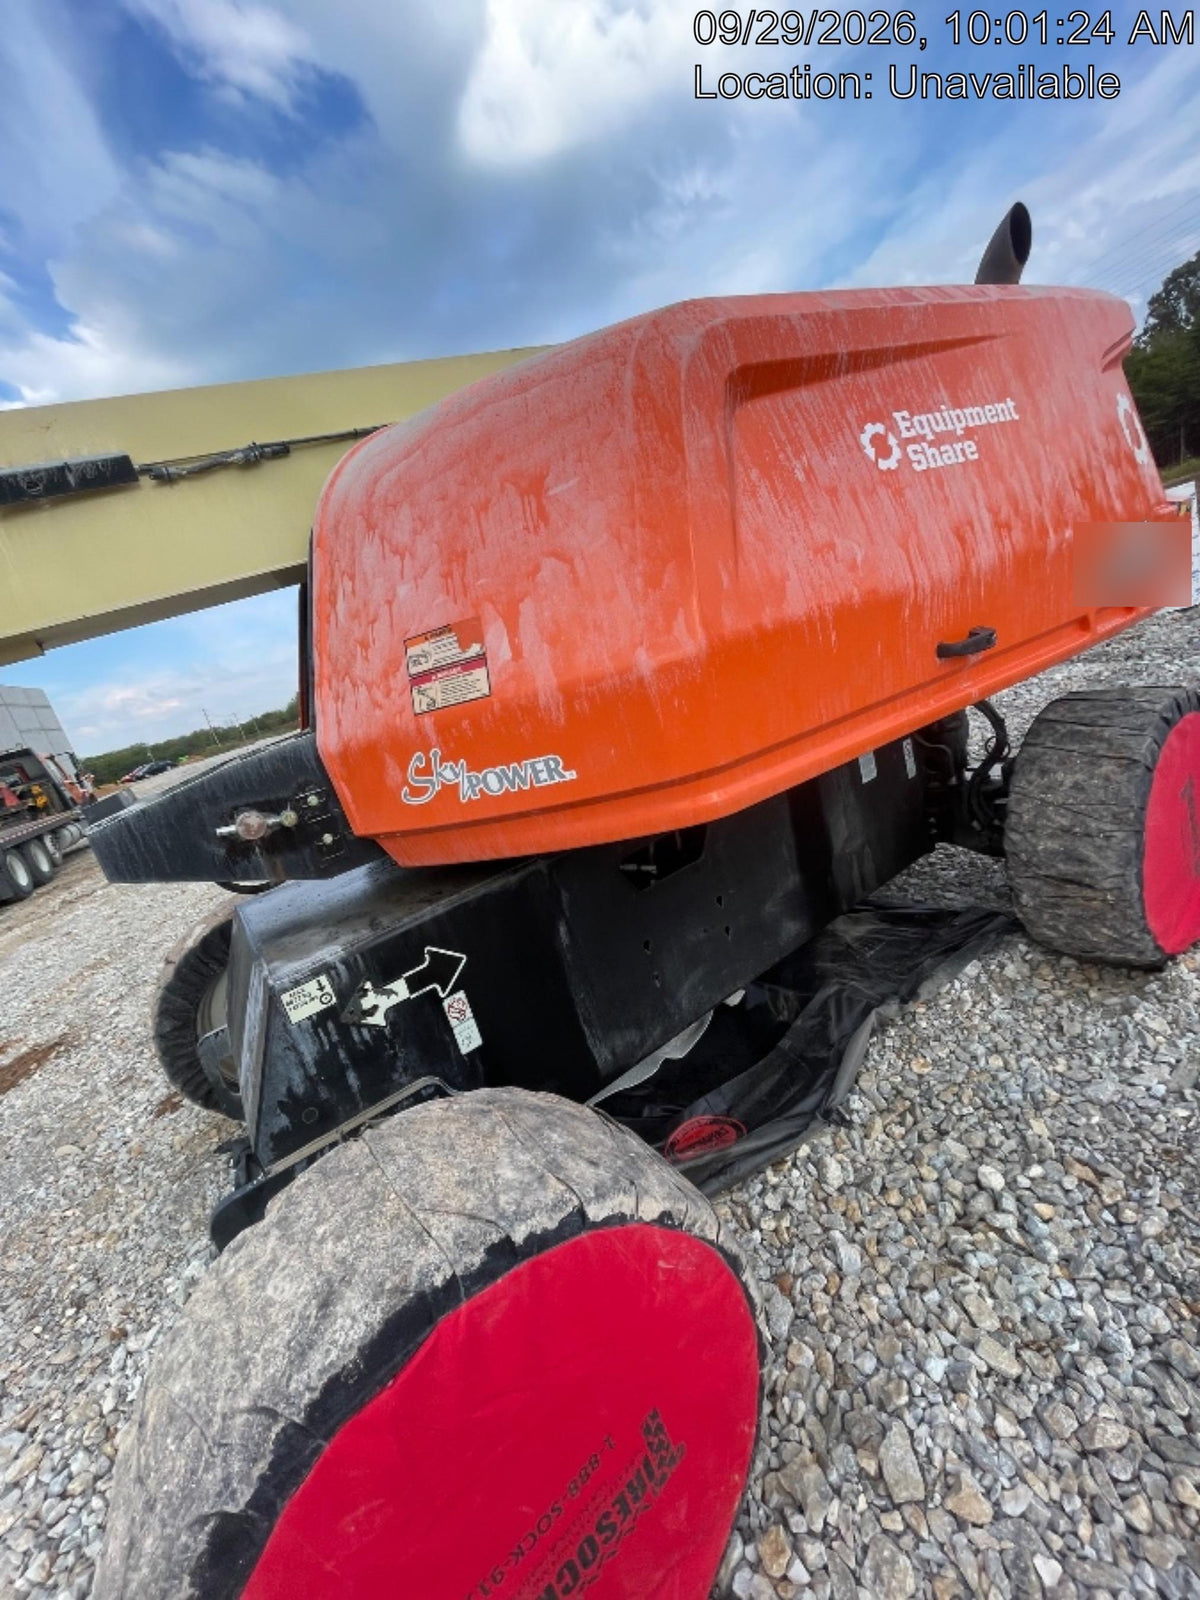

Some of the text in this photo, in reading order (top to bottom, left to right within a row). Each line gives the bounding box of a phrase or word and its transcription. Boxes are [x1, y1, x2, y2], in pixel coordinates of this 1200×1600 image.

[892, 397, 1019, 441] Equipment
[906, 438, 979, 472] Share
[466, 1434, 616, 1600] 1-888-SOCK-91
